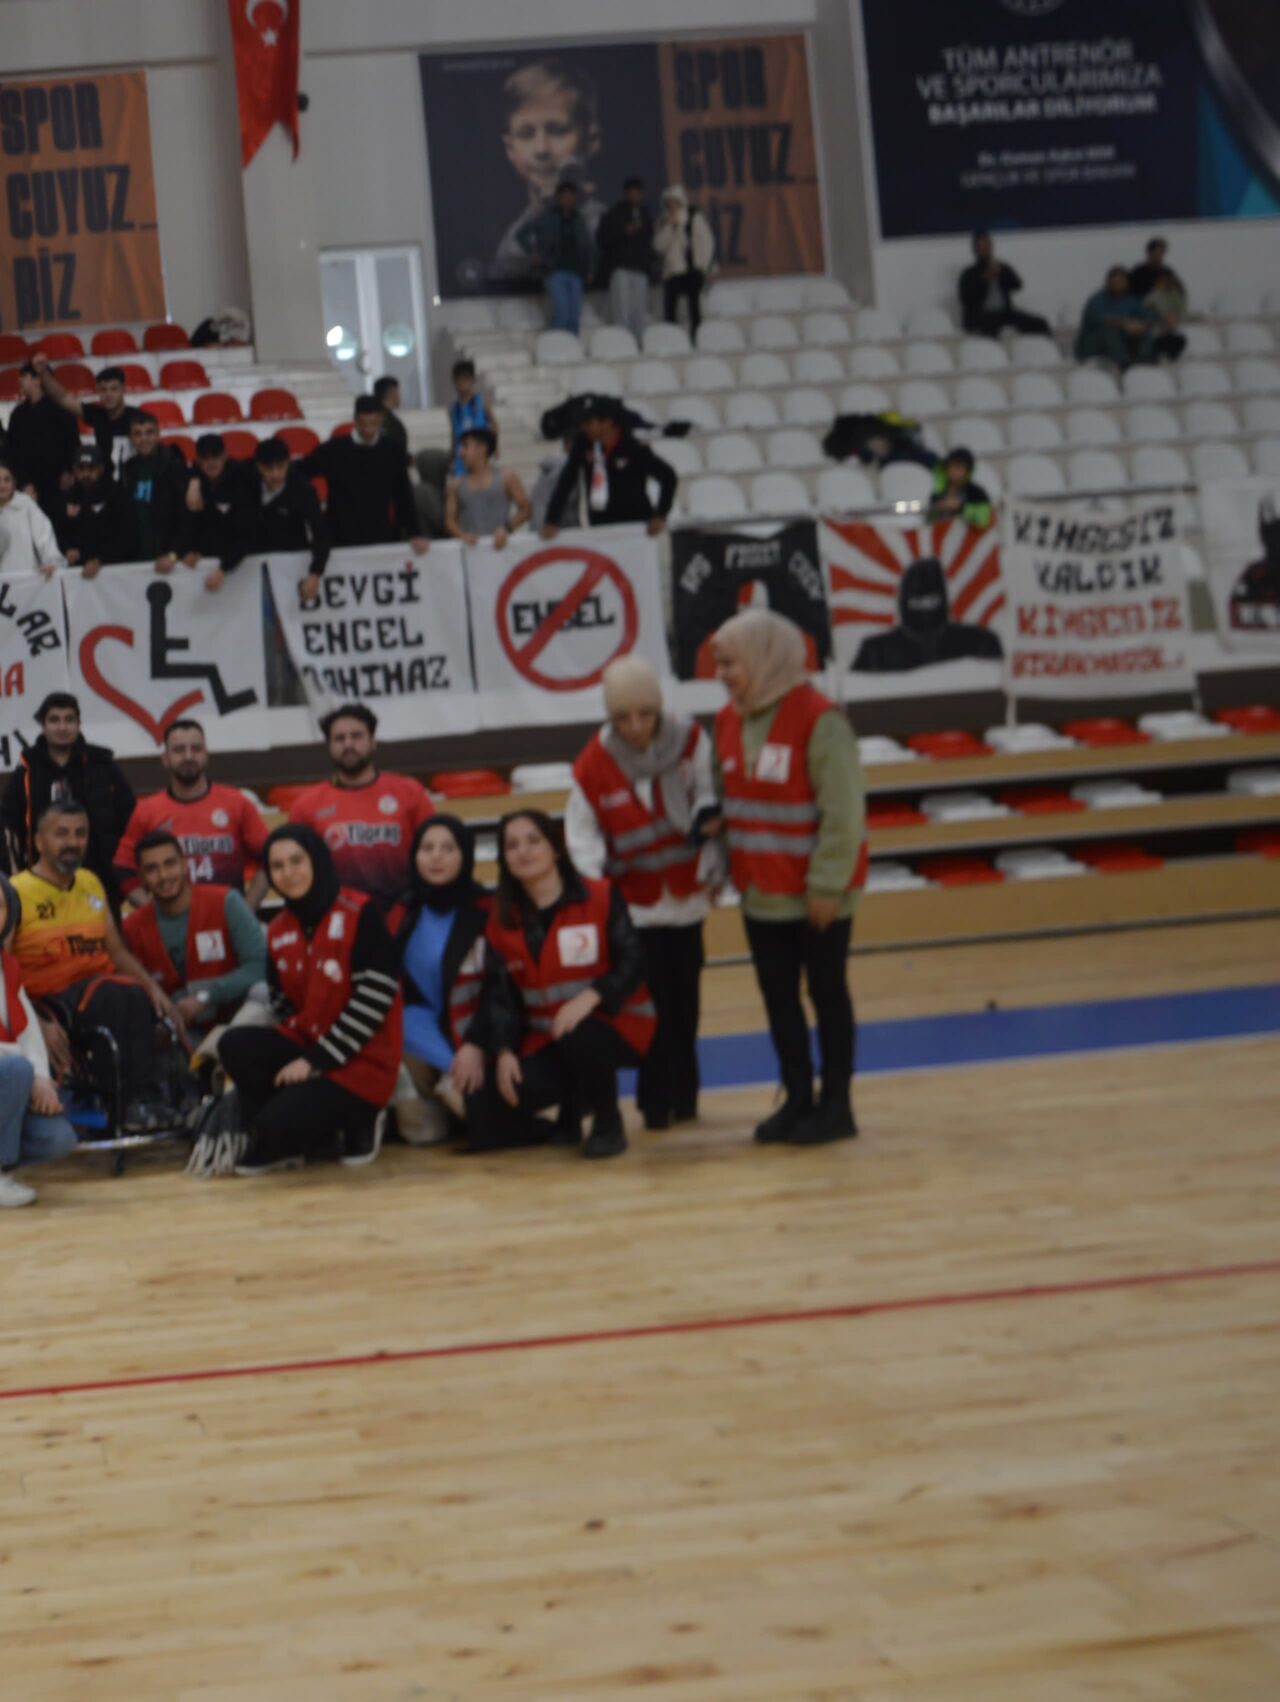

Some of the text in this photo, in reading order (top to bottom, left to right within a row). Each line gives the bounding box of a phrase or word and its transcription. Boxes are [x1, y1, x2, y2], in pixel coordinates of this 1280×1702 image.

[13, 246, 81, 324] BİZ
[301, 613, 426, 658] ENGEL
[187, 857, 214, 884] 14
